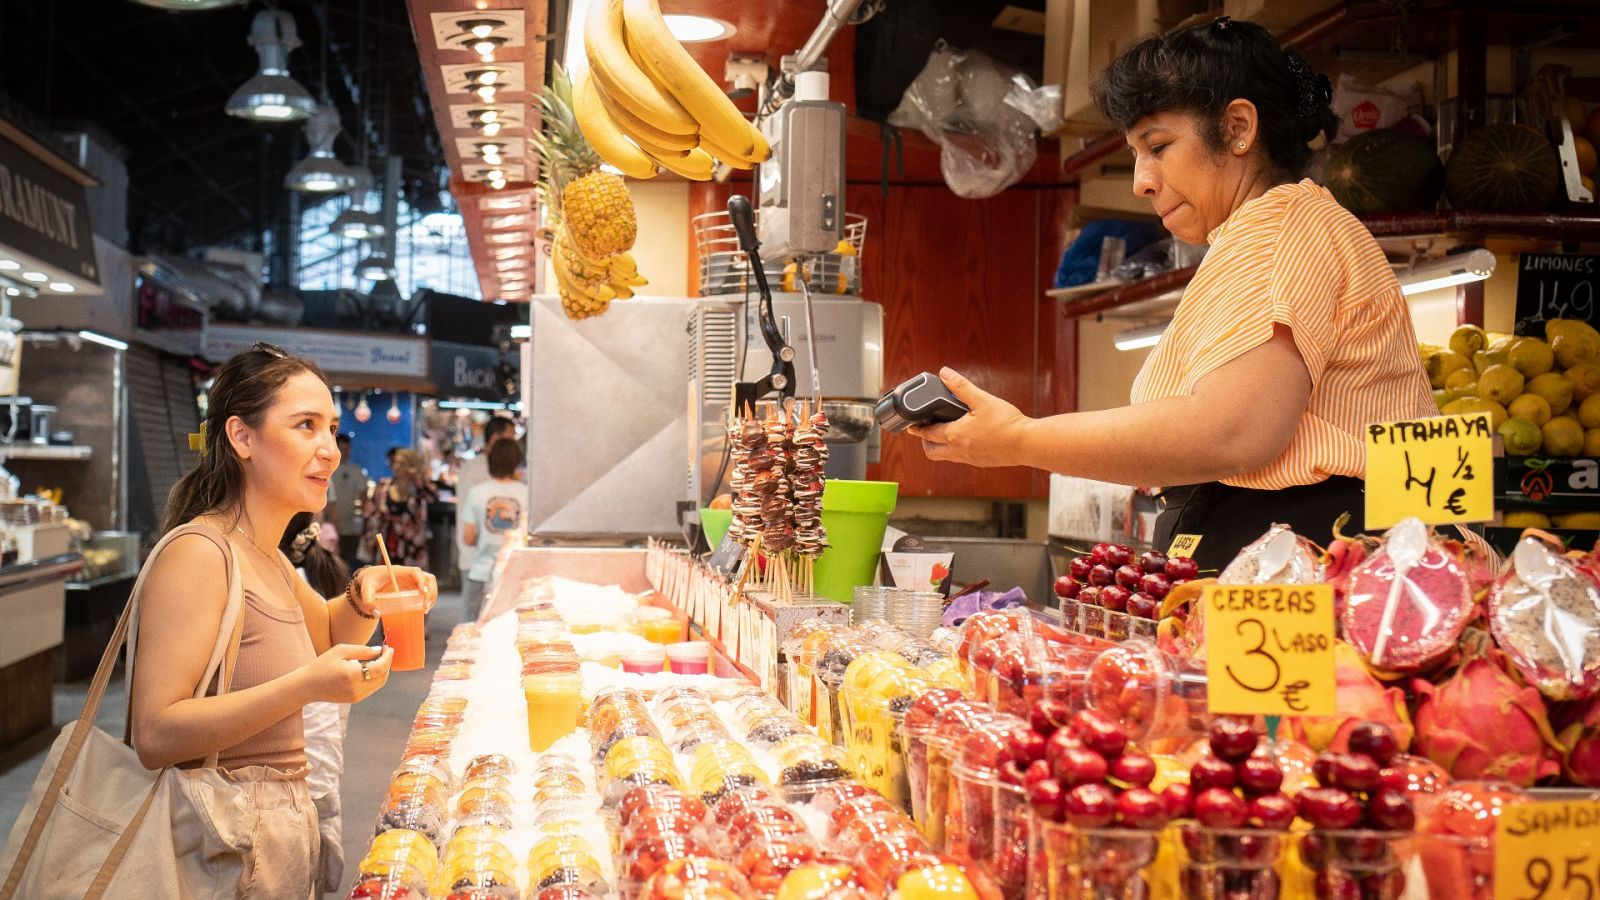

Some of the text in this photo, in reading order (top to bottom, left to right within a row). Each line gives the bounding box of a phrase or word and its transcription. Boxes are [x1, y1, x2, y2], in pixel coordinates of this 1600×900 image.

[1524, 255, 1594, 274] LIMONES
[1368, 415, 1491, 445] PITAHAYA
[1212, 587, 1316, 615] CEREZAS
[1224, 617, 1281, 694] 3
